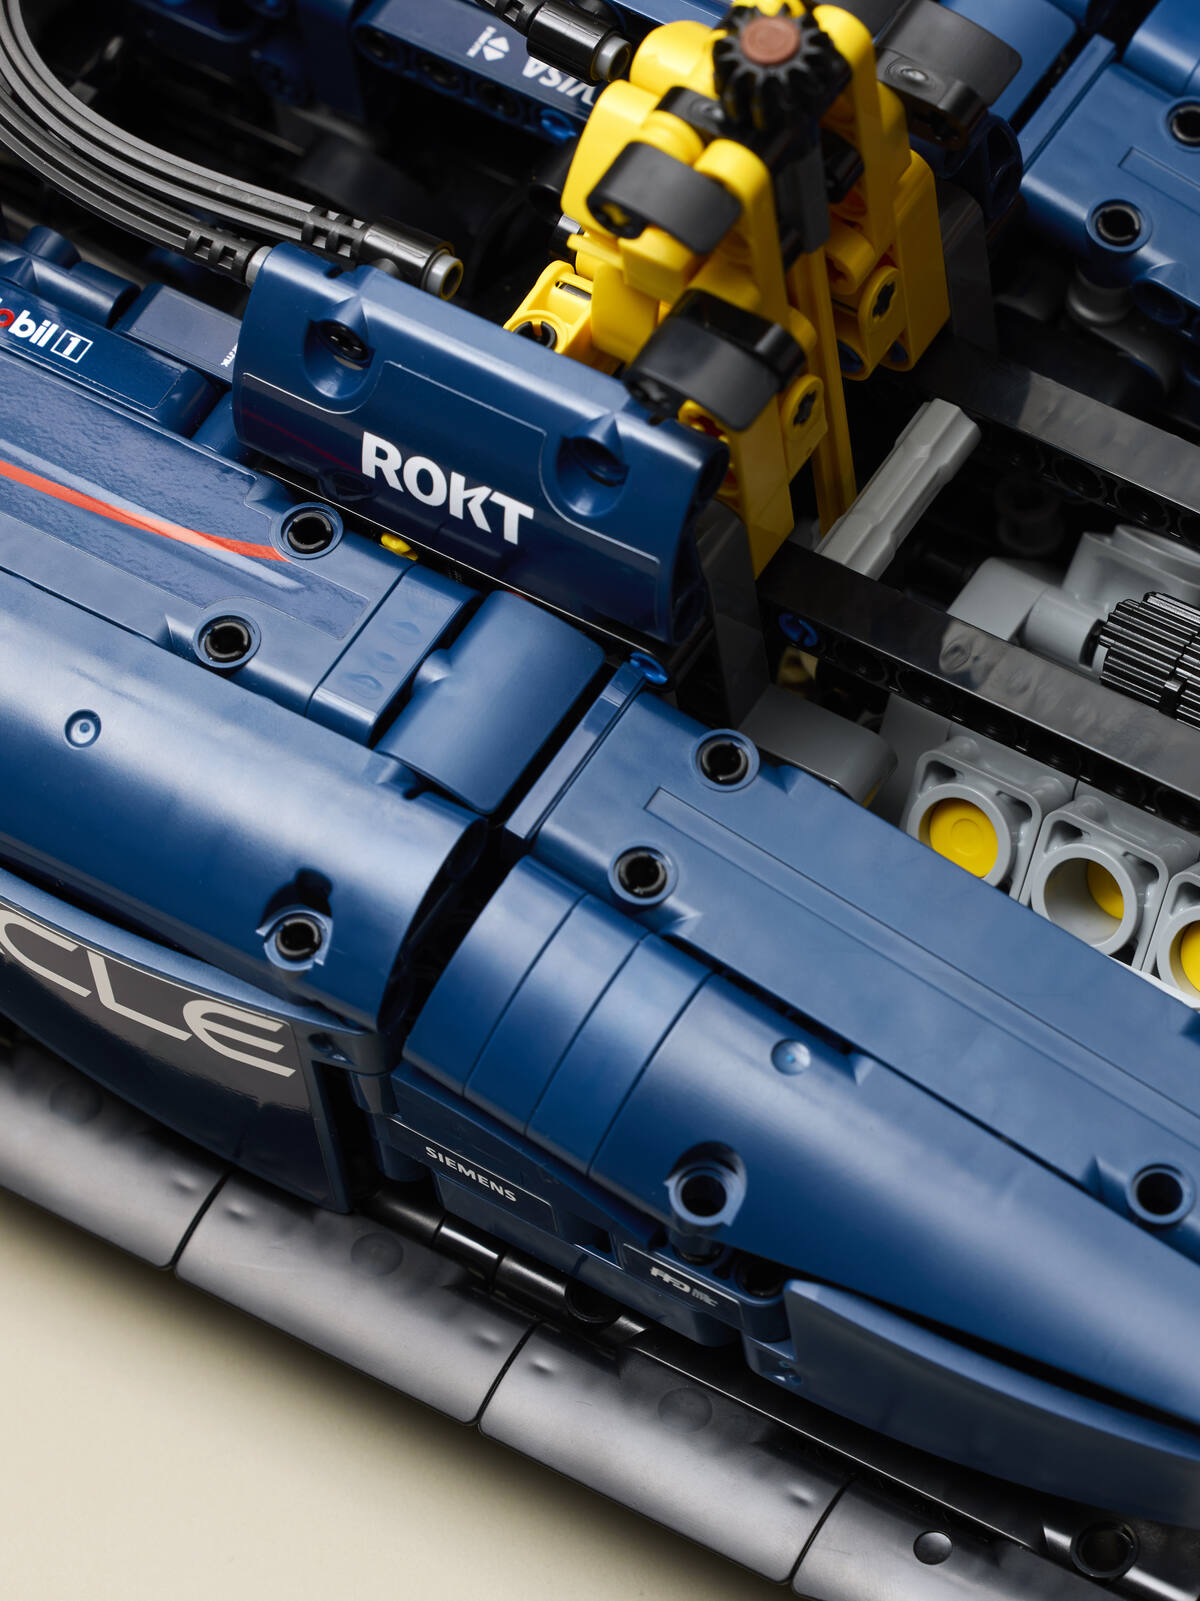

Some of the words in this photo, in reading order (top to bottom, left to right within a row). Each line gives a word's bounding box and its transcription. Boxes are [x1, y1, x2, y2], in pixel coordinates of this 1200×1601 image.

[0, 307, 59, 348] obil
[361, 431, 535, 545] ROKT
[0, 909, 297, 1078] CLE
[425, 1146, 517, 1202] SIEMENS
